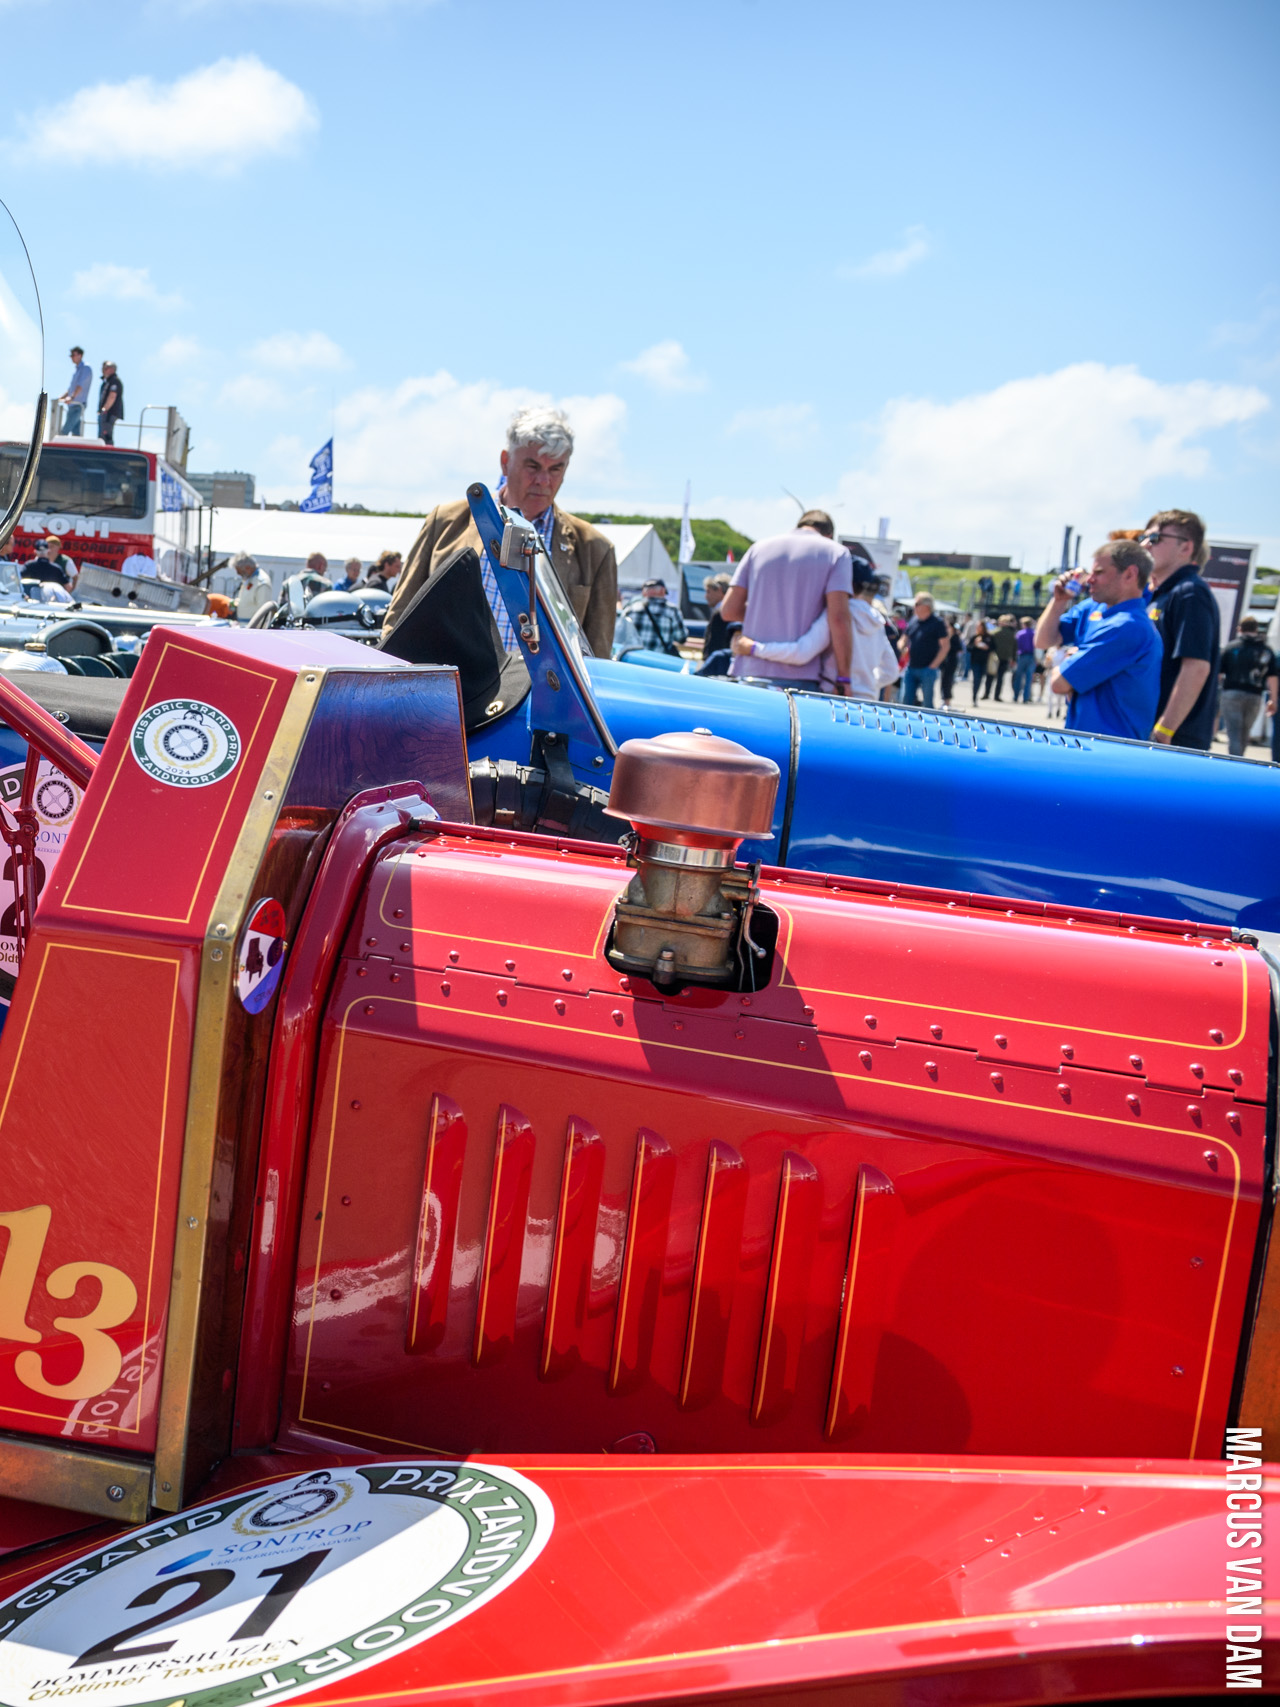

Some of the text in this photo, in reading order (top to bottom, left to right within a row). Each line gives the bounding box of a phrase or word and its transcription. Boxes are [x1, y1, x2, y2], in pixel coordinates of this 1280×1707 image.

[23, 515, 110, 538] KONI
[62, 541, 125, 554] BSORBER
[135, 701, 184, 739] HISTORIC
[190, 703, 231, 731] GRAND
[227, 735, 238, 761] PRIX
[139, 755, 217, 784] ZANDVOORT
[165, 765, 191, 775] 2024
[378, 1468, 499, 1505] PRIX
[210, 1545, 305, 1567] VERZEKERINGEN
[218, 1520, 372, 1557] SONTROP
[16, 1510, 222, 1609] GRAND
[68, 1548, 335, 1669] 21
[251, 1496, 525, 1698] ZANDVOORT
[28, 1654, 281, 1701] Oldtimer Taxaties
[31, 1637, 304, 1689] DOMMERSHUIZEN
